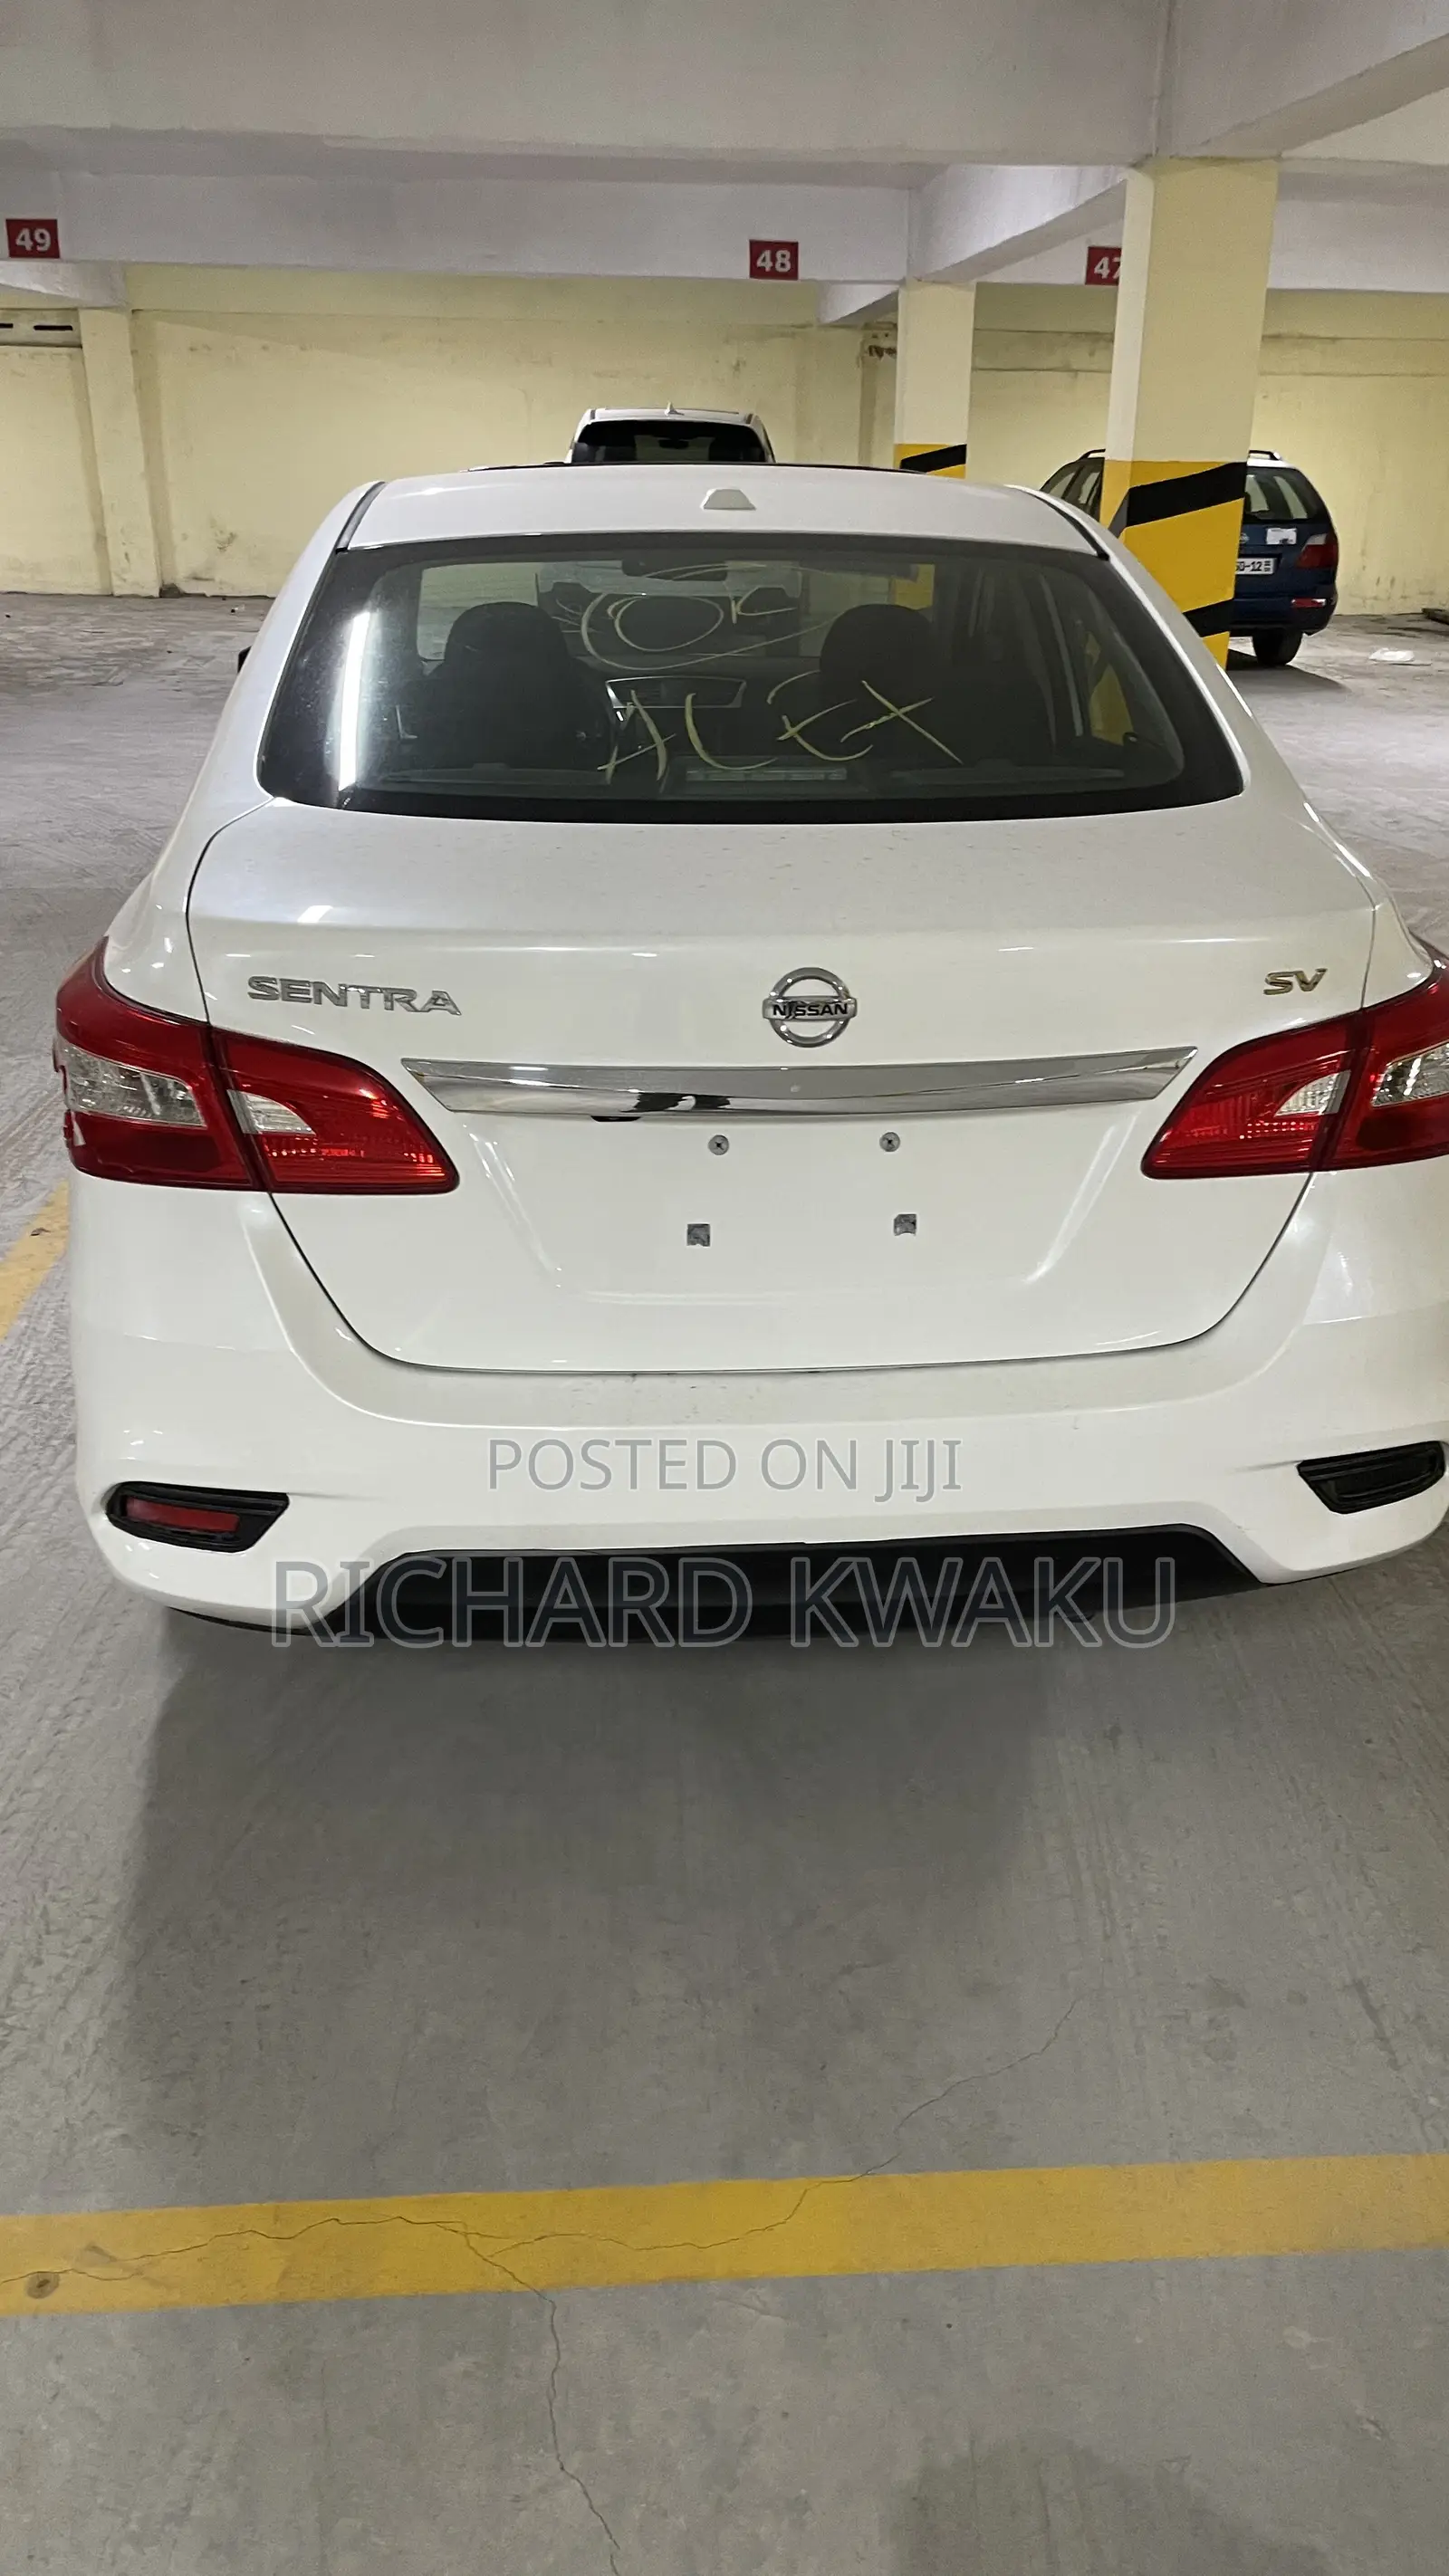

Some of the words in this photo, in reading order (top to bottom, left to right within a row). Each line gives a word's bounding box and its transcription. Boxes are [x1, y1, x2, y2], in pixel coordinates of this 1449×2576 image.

[15, 227, 52, 252] 49
[756, 249, 792, 273] 48
[1262, 968, 1329, 996] SV
[247, 975, 463, 1016] SENTRA
[772, 1001, 849, 1018] NISSAN
